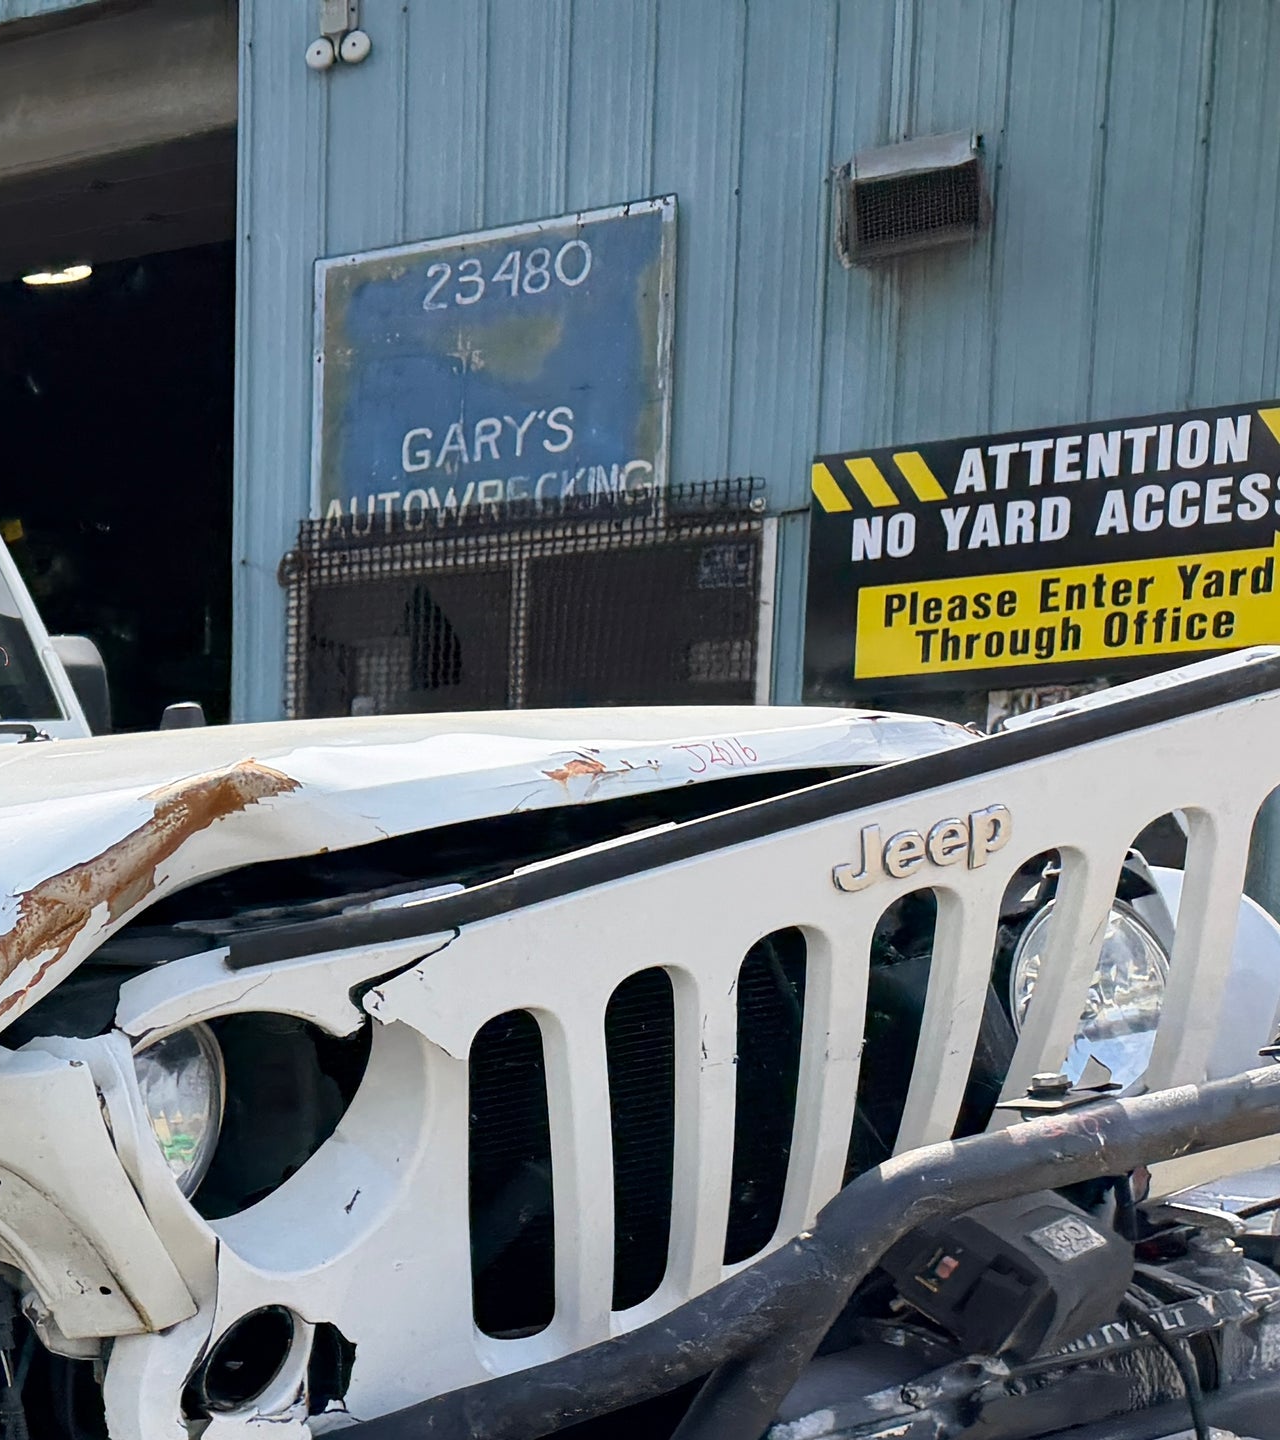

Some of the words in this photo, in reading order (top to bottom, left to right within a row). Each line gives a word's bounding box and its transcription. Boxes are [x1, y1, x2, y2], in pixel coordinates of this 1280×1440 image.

[423, 240, 592, 311] 23480
[401, 406, 575, 473] GARY'S
[953, 414, 1252, 495] ATTENTION
[851, 512, 916, 563] NO
[940, 495, 1072, 552] YARD
[1094, 472, 1280, 537] ACCES
[884, 589, 1018, 629] Please
[1039, 573, 1155, 613] Enter
[1177, 556, 1275, 602] Yard
[915, 617, 1081, 660] Through
[1103, 607, 1236, 649] Office
[832, 803, 1012, 893] Jeep
